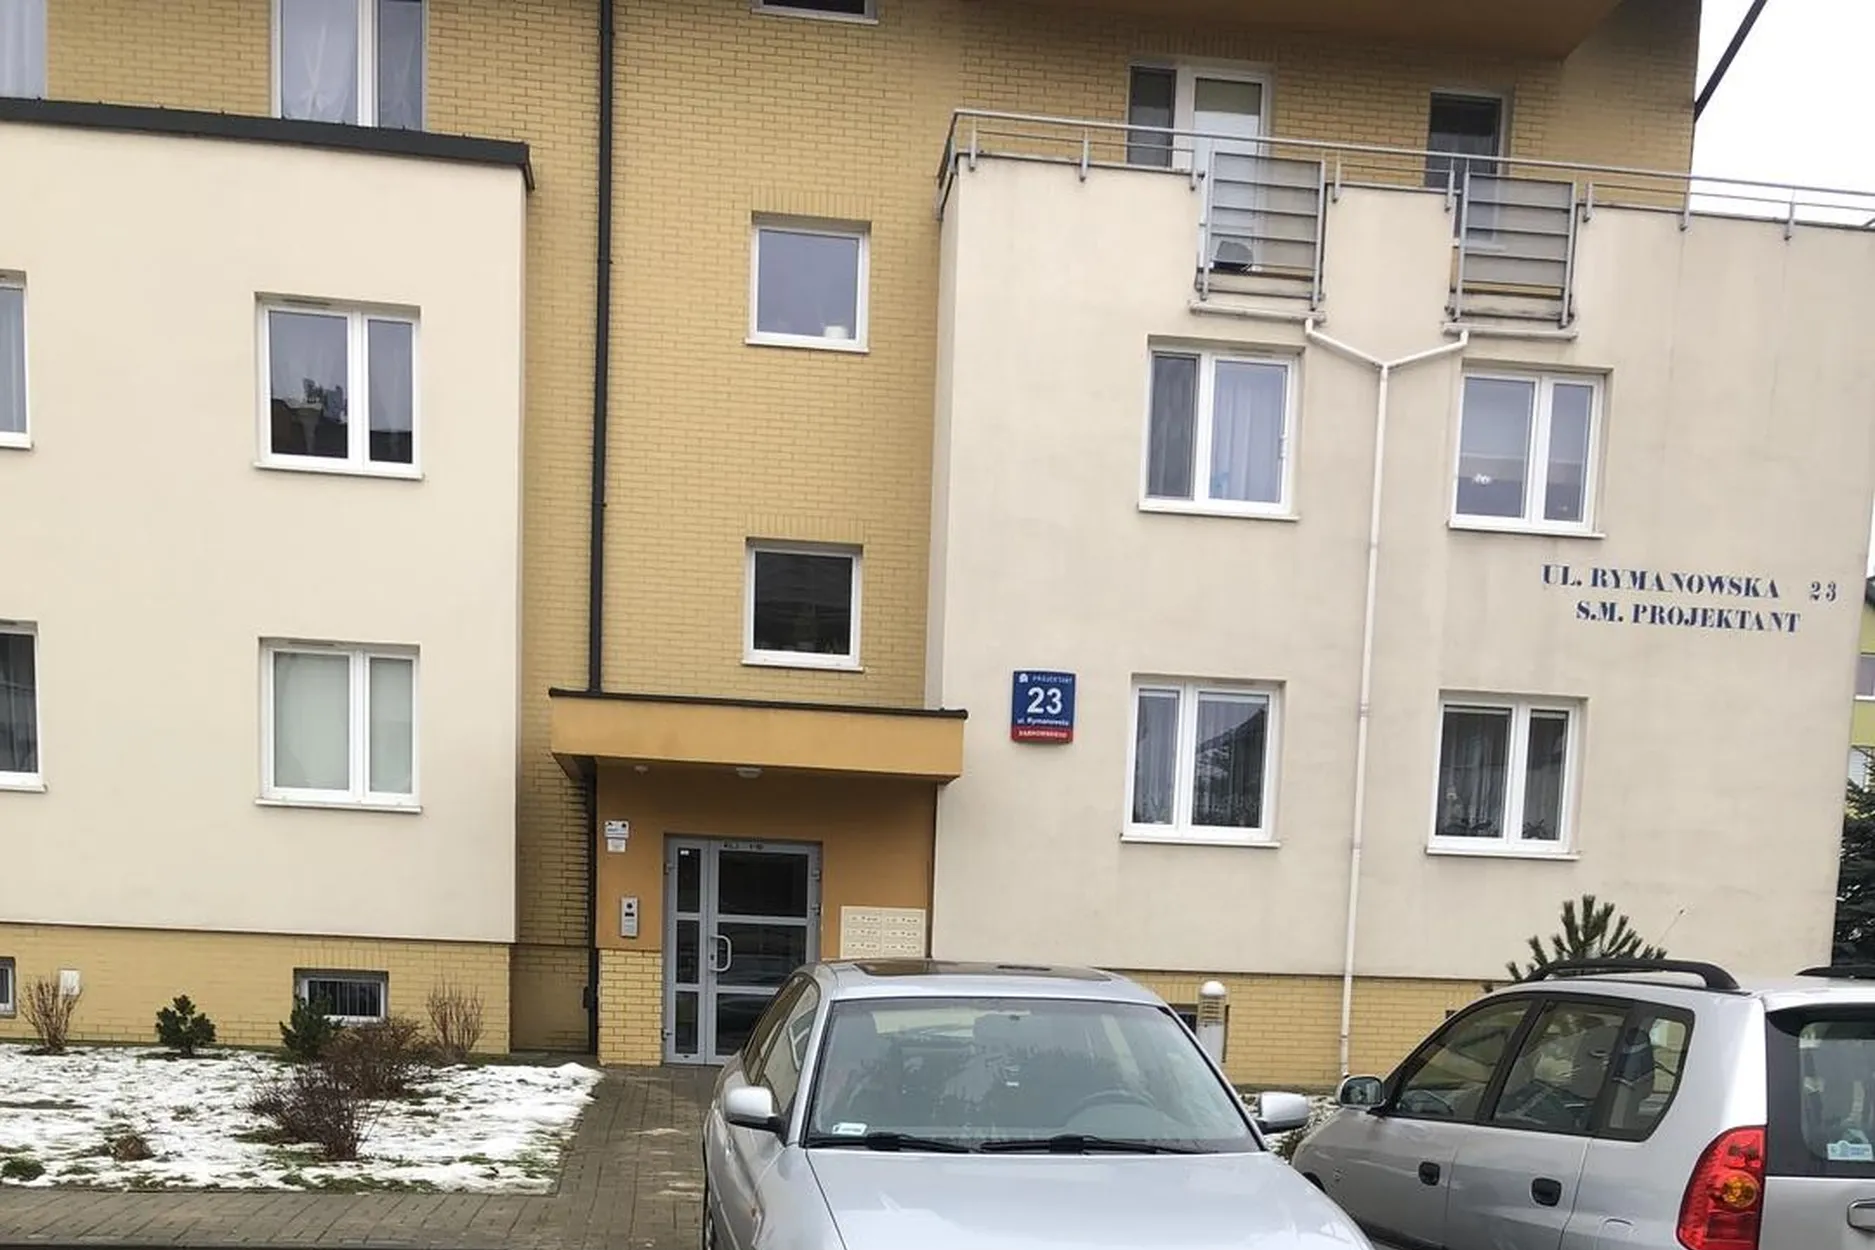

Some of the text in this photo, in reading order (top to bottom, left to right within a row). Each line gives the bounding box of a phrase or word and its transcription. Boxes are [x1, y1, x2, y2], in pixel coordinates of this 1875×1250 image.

[1542, 564, 1838, 602] UL. RYMANOWSKA 23
[1576, 600, 1801, 633] S.M. PROJEKTANT
[1027, 687, 1062, 715] 23
